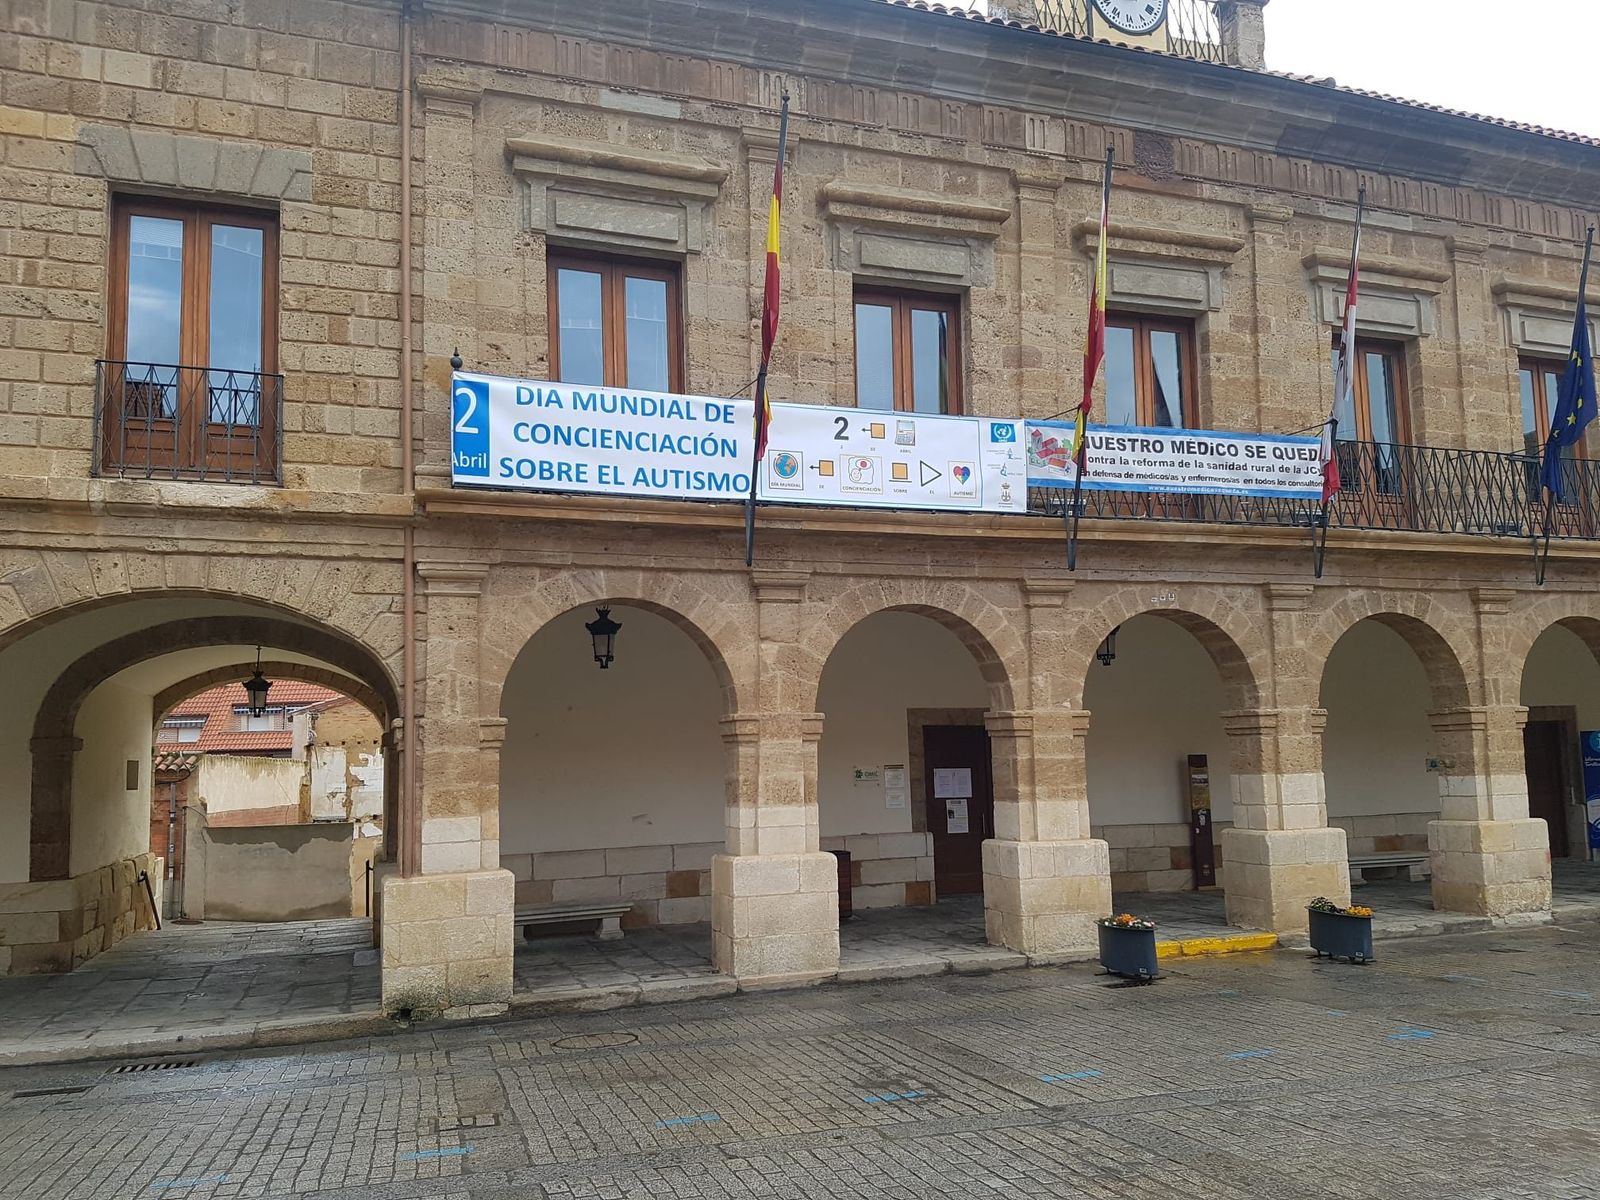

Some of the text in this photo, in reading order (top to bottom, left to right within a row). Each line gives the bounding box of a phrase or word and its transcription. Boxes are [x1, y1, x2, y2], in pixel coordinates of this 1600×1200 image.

[455, 387, 479, 434] 2
[516, 386, 735, 424] DIA MUNDIAL DE
[513, 422, 737, 458] CONCIENCIACIÓN
[834, 416, 849, 441] 2
[453, 451, 487, 469] Abril
[1245, 443, 1267, 459] SE
[1272, 447, 1320, 462] QUED
[499, 457, 750, 493] SOBRE EL AUTISMO
[1088, 455, 1322, 476] ontra la reforma de la sanidad rural de la JCy
[1092, 470, 1122, 478] defensa
[1124, 471, 1134, 479] de
[1255, 477, 1276, 486] todos
[1277, 478, 1287, 486] los
